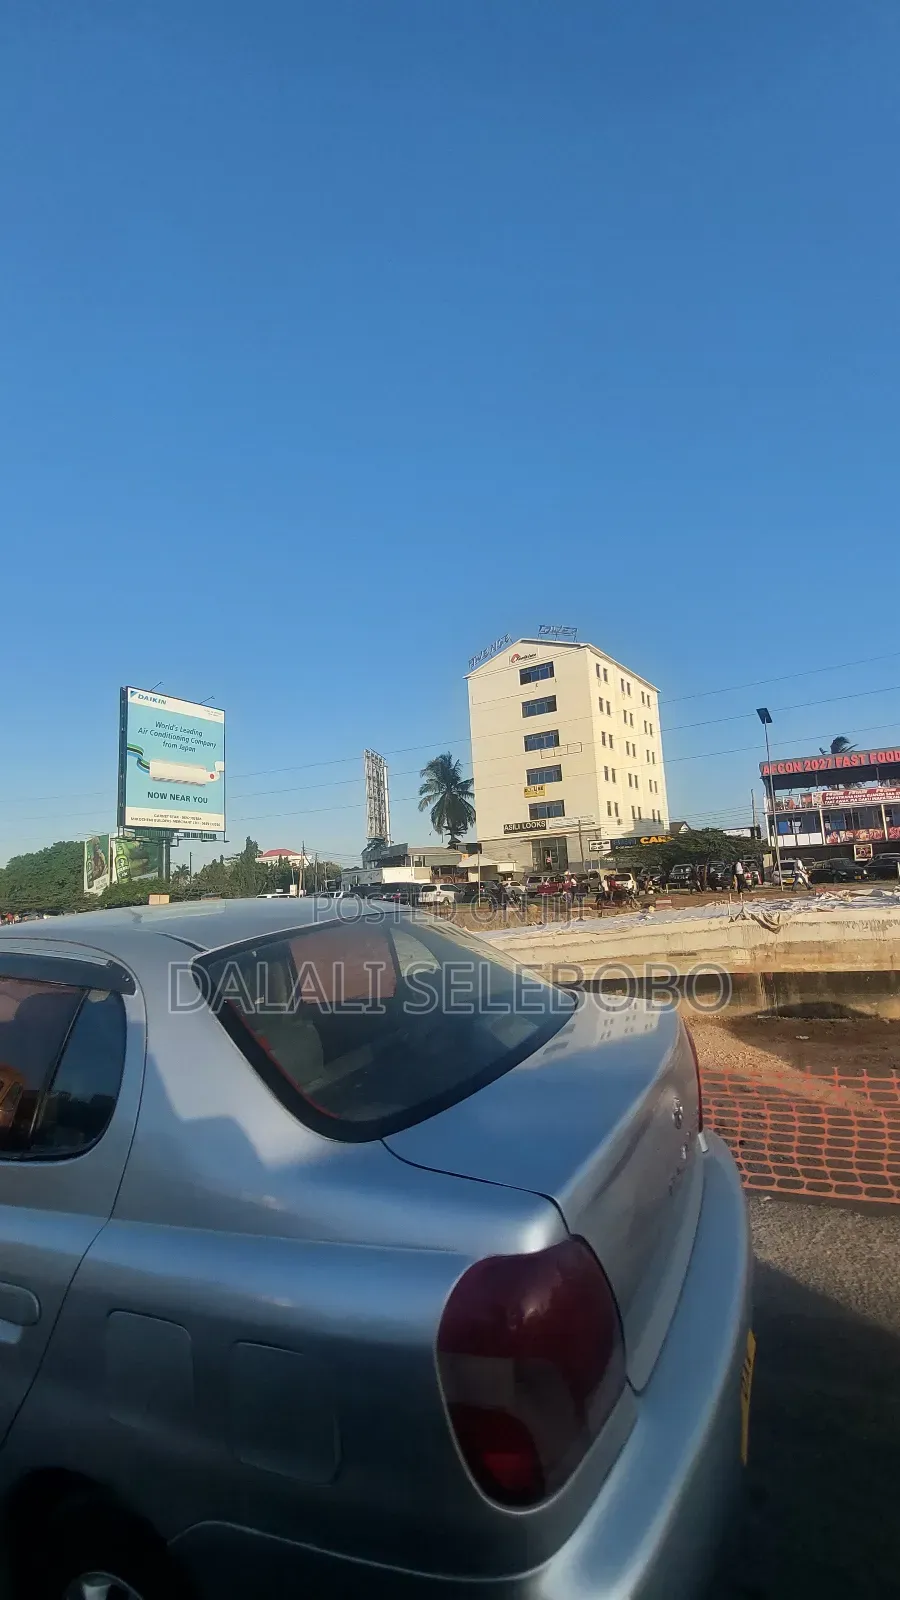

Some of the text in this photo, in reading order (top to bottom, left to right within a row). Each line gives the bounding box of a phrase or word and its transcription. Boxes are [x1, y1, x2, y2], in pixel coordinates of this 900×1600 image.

[138, 693, 167, 705] DAIKIN
[155, 721, 203, 737] World's Leading
[138, 727, 217, 749] Air Conditioning Company
[162, 740, 196, 753] from Japan
[763, 749, 900, 776] AFCON 2027 FAST FOOD
[147, 791, 208, 804] NOW NEAR YOU
[504, 820, 546, 831] ASILI LOOKS
